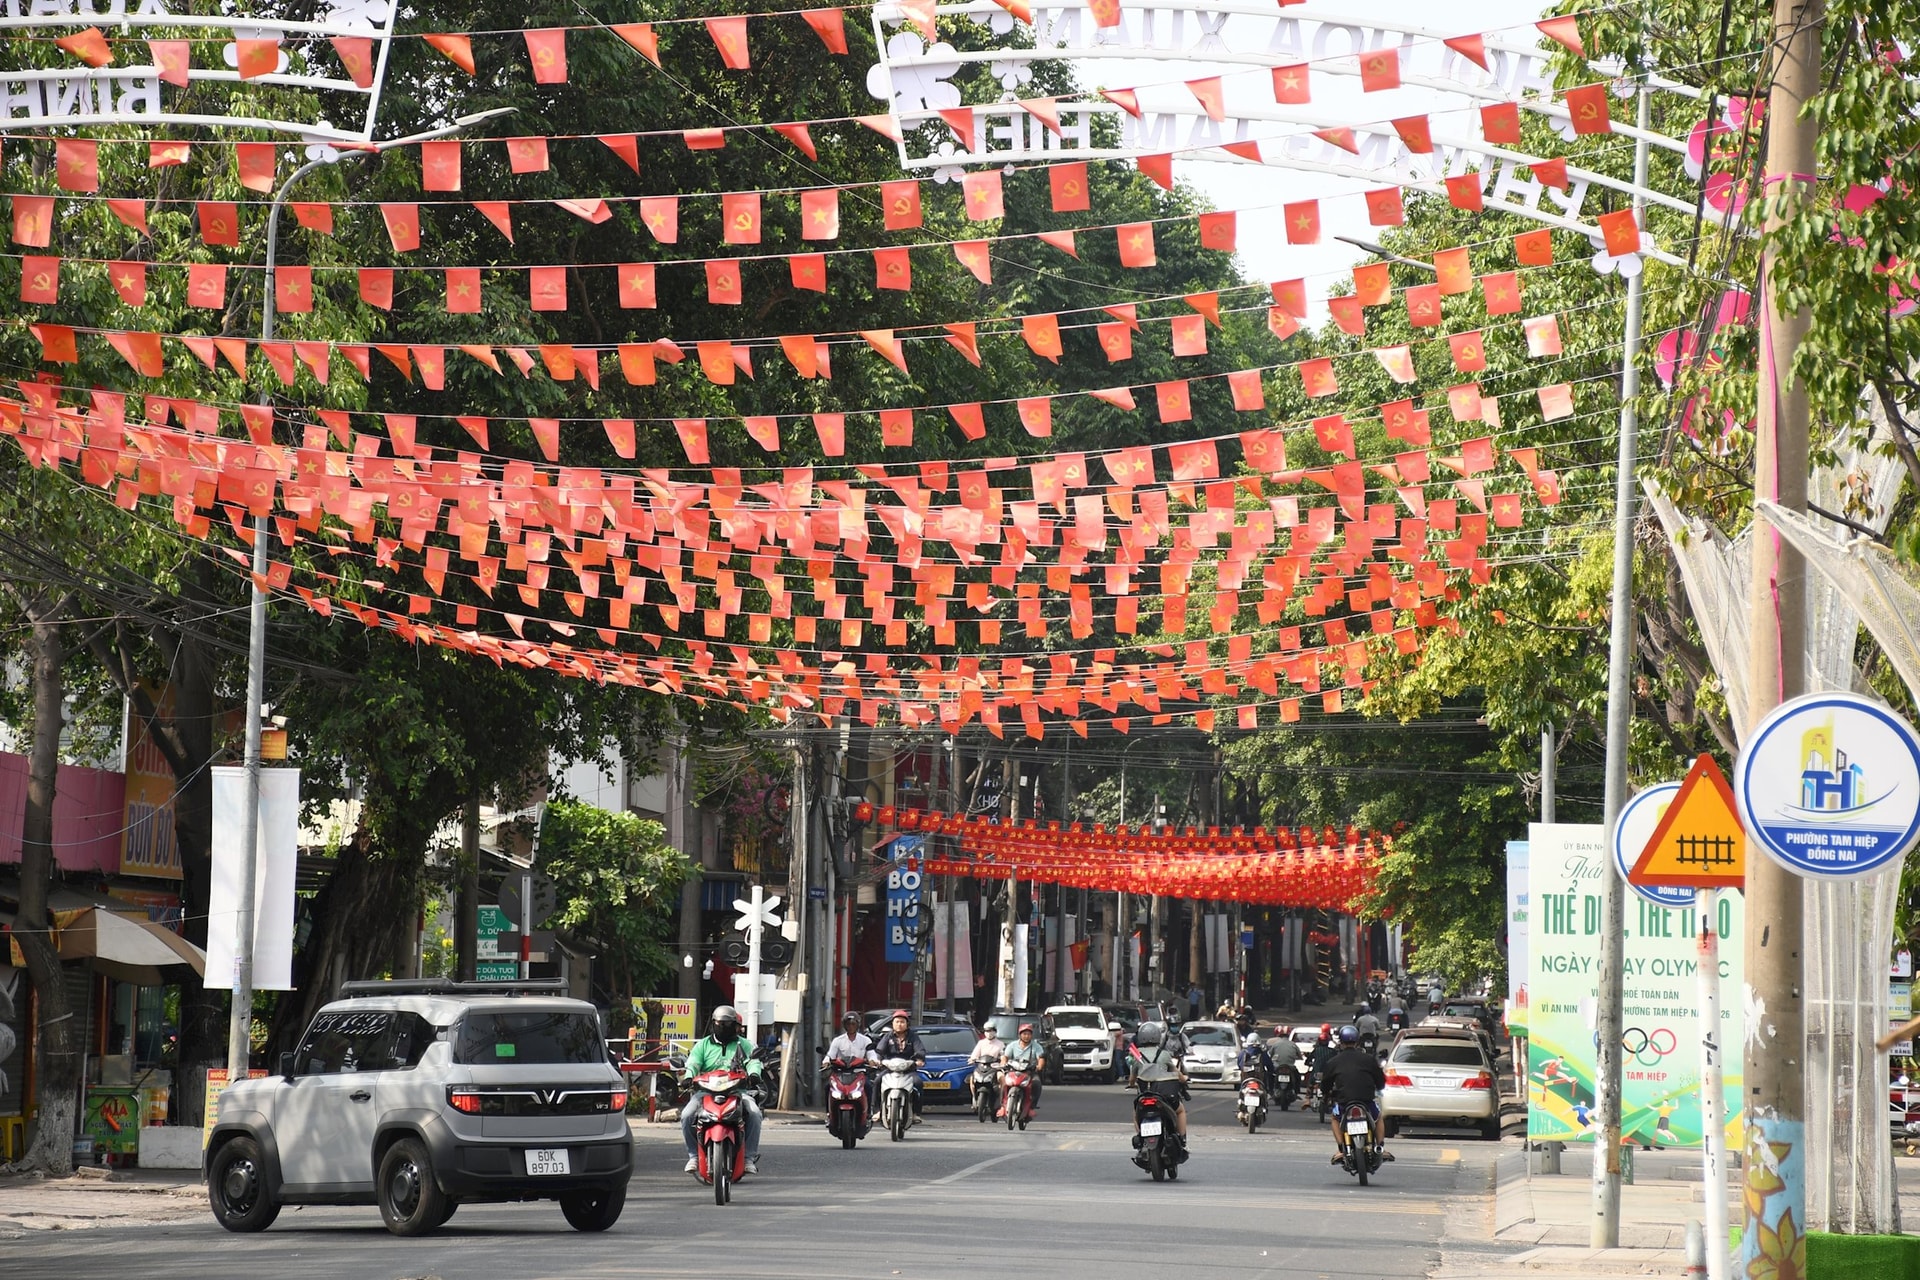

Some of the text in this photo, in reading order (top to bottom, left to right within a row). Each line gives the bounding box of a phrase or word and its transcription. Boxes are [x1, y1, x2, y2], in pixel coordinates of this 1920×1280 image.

[1576, 843, 1592, 851] BAN
[1830, 834, 1852, 847] TAM
[1854, 834, 1879, 850] HIỆP
[1838, 850, 1857, 862] NAI
[1679, 888, 1692, 897] NAI
[1542, 879, 1577, 935] THỂ
[1541, 951, 1592, 974] NGÀY
[1551, 1004, 1562, 1013] AN
[1653, 1007, 1669, 1017] TAM
[1626, 1071, 1667, 1082] TAM HIỆP
[537, 1151, 556, 1162] 60K
[532, 1162, 565, 1174] 897.03
